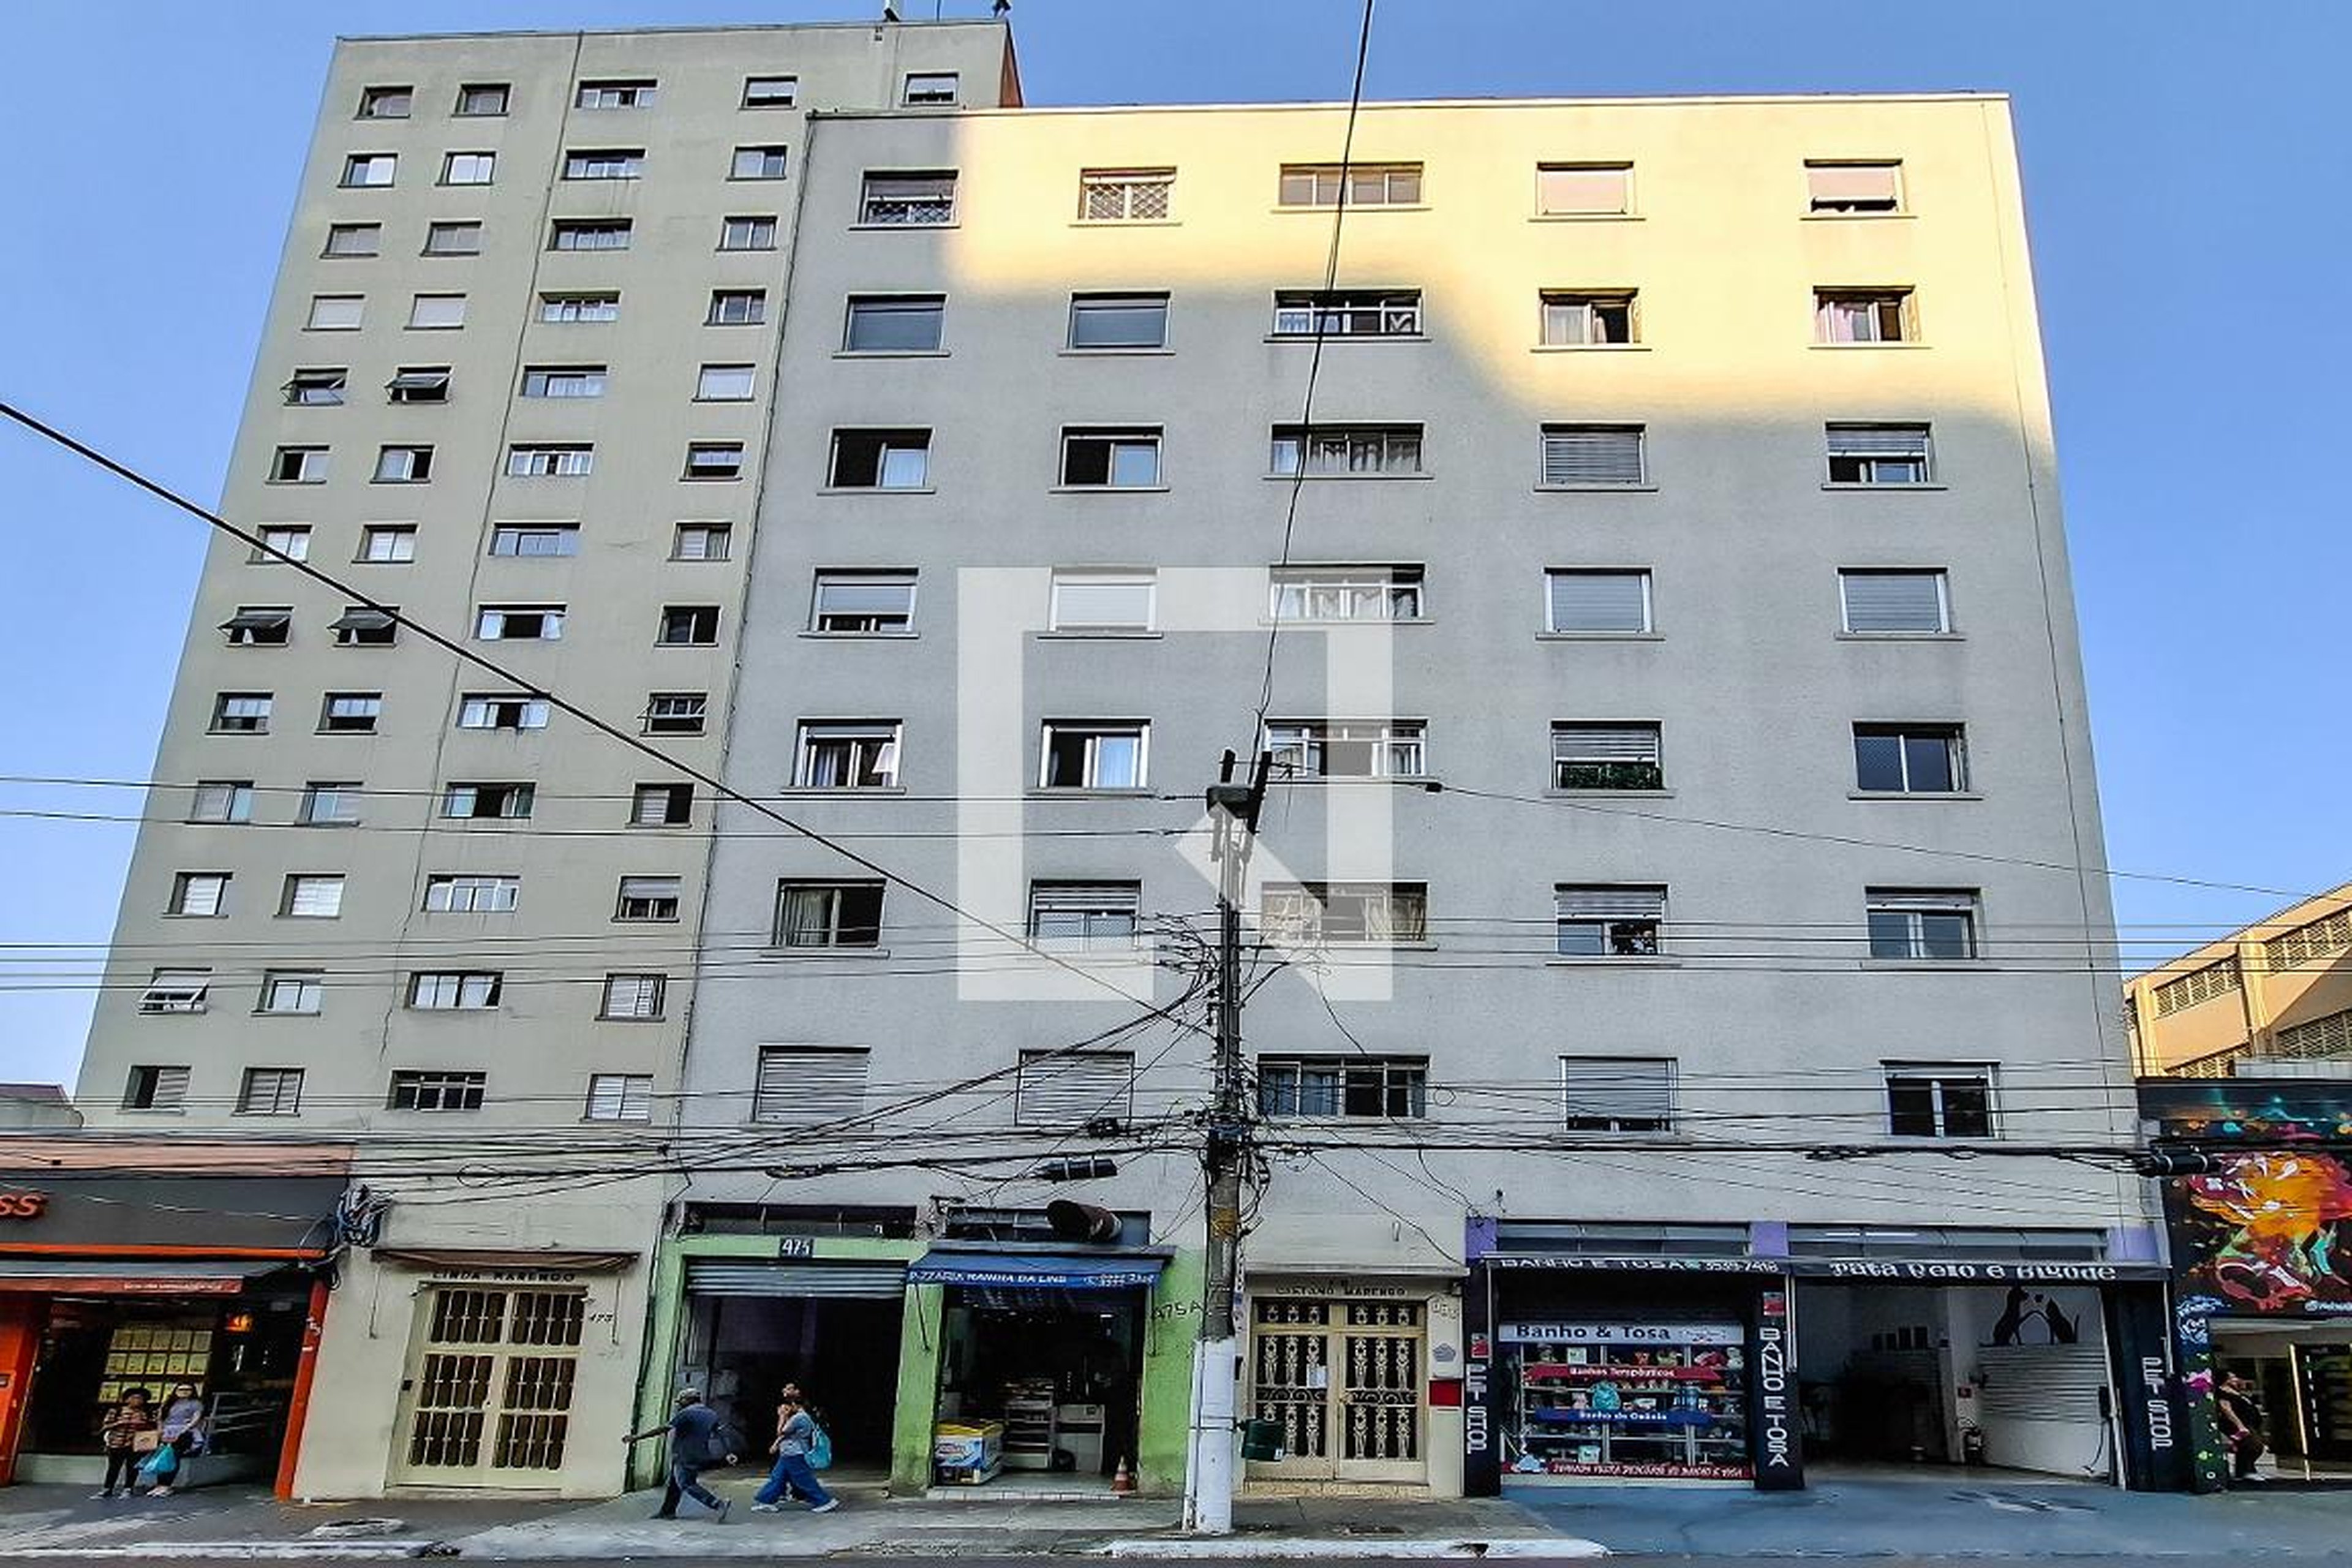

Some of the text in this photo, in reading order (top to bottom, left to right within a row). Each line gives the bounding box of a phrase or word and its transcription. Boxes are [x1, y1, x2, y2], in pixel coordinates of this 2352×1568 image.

[1517, 1324, 1588, 1339] Banho
[1596, 1325, 1612, 1339] &
[1623, 1326, 1671, 1340] Tosa
[1466, 1363, 1487, 1455] PET SHOP
[1759, 1327, 1789, 1467] BANHO E TOSA
[2143, 1357, 2173, 1451] PET SHOP
